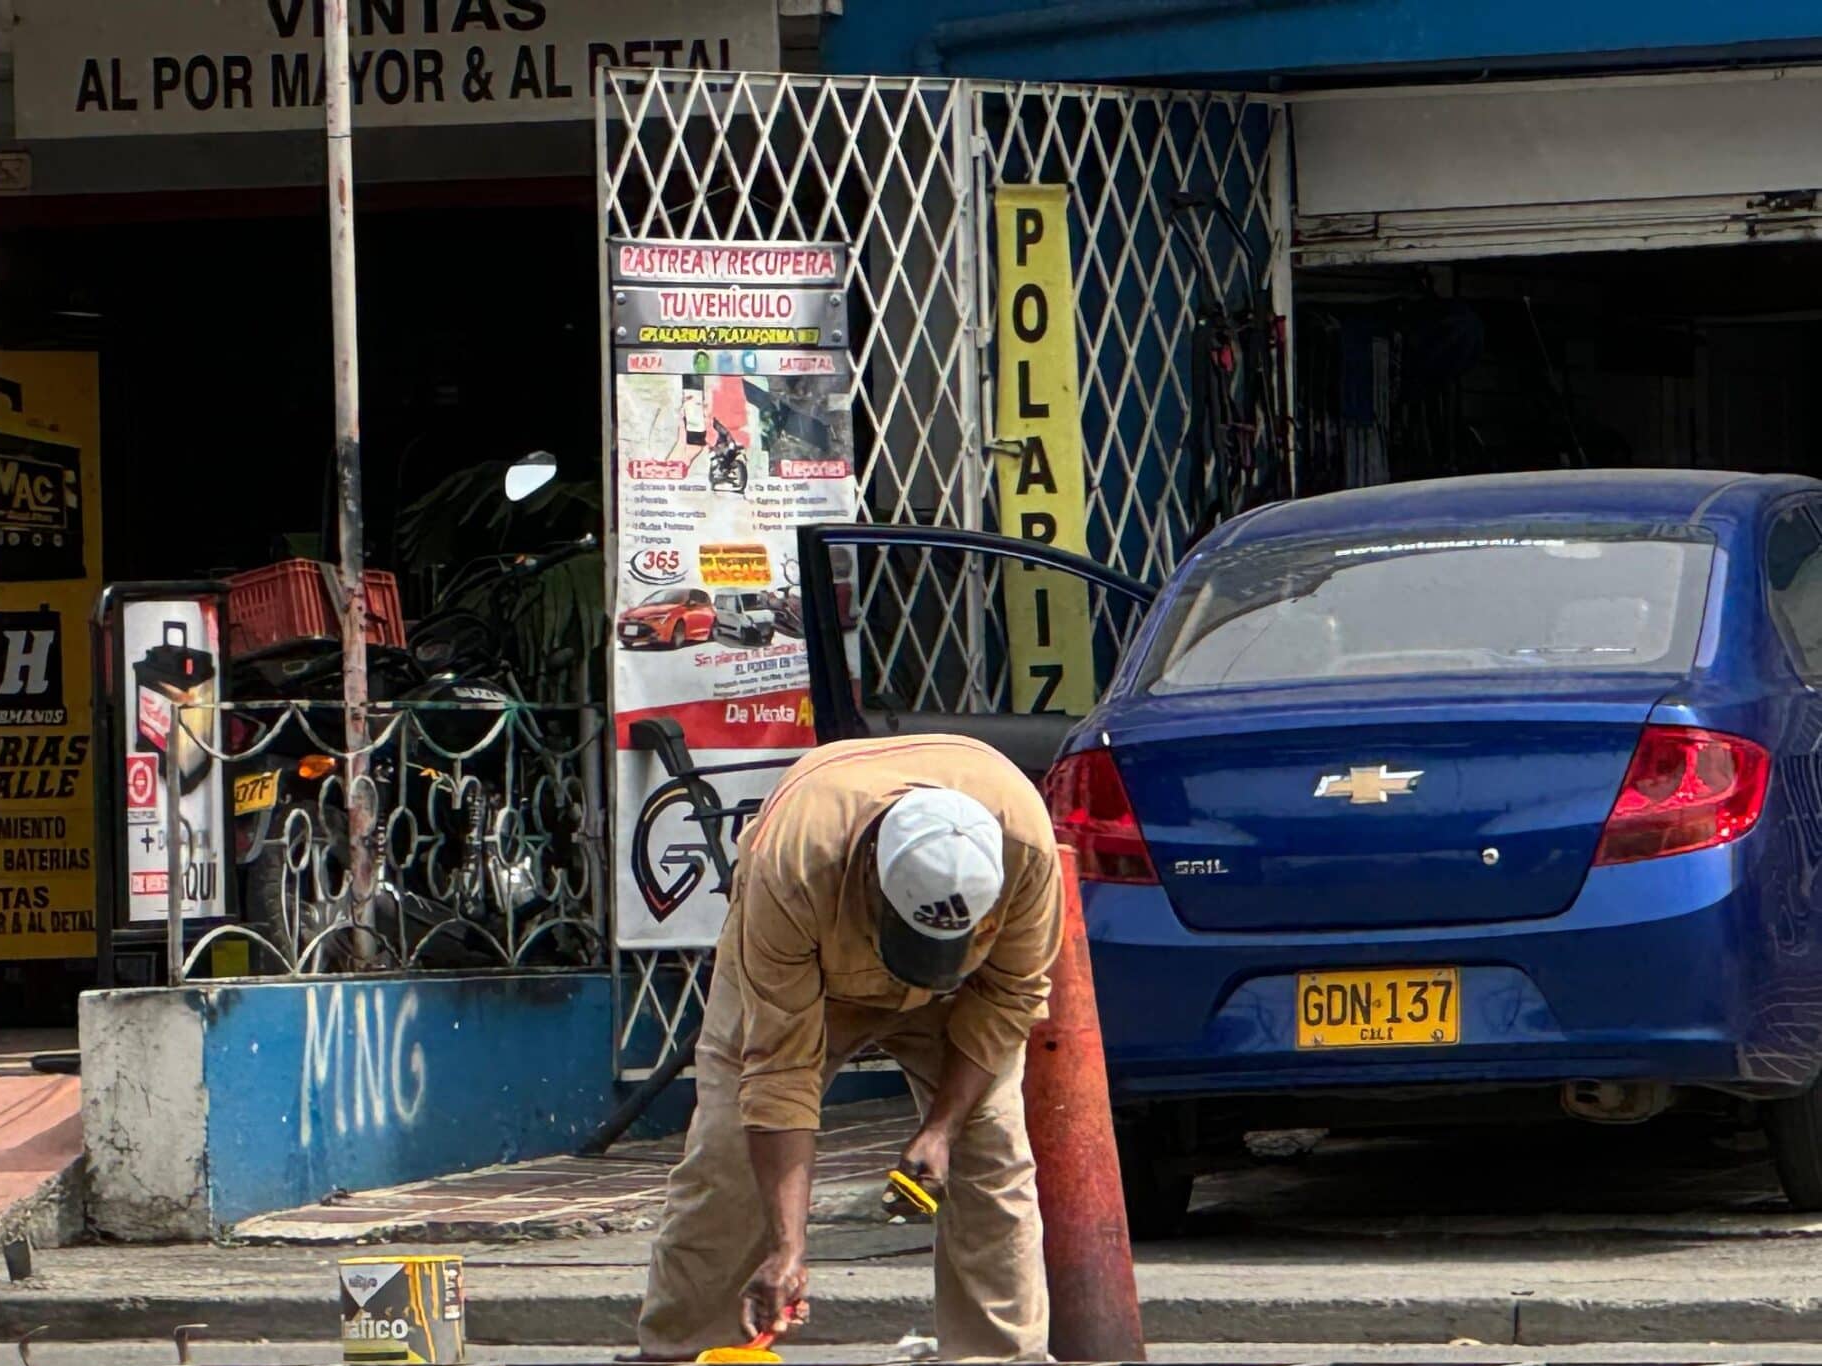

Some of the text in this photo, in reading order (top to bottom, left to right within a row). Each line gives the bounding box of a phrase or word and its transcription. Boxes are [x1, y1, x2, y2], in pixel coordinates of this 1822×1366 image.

[265, 0, 546, 38] VNTAS
[76, 58, 138, 112] AL
[152, 55, 253, 109] POR
[461, 47, 495, 101] &
[510, 44, 573, 99] AL
[728, 249, 837, 278] RECUPERA
[660, 292, 687, 318] TU
[642, 550, 679, 570] 365
[1303, 980, 1454, 1027] GDN 137
[300, 982, 426, 1148] MNG
